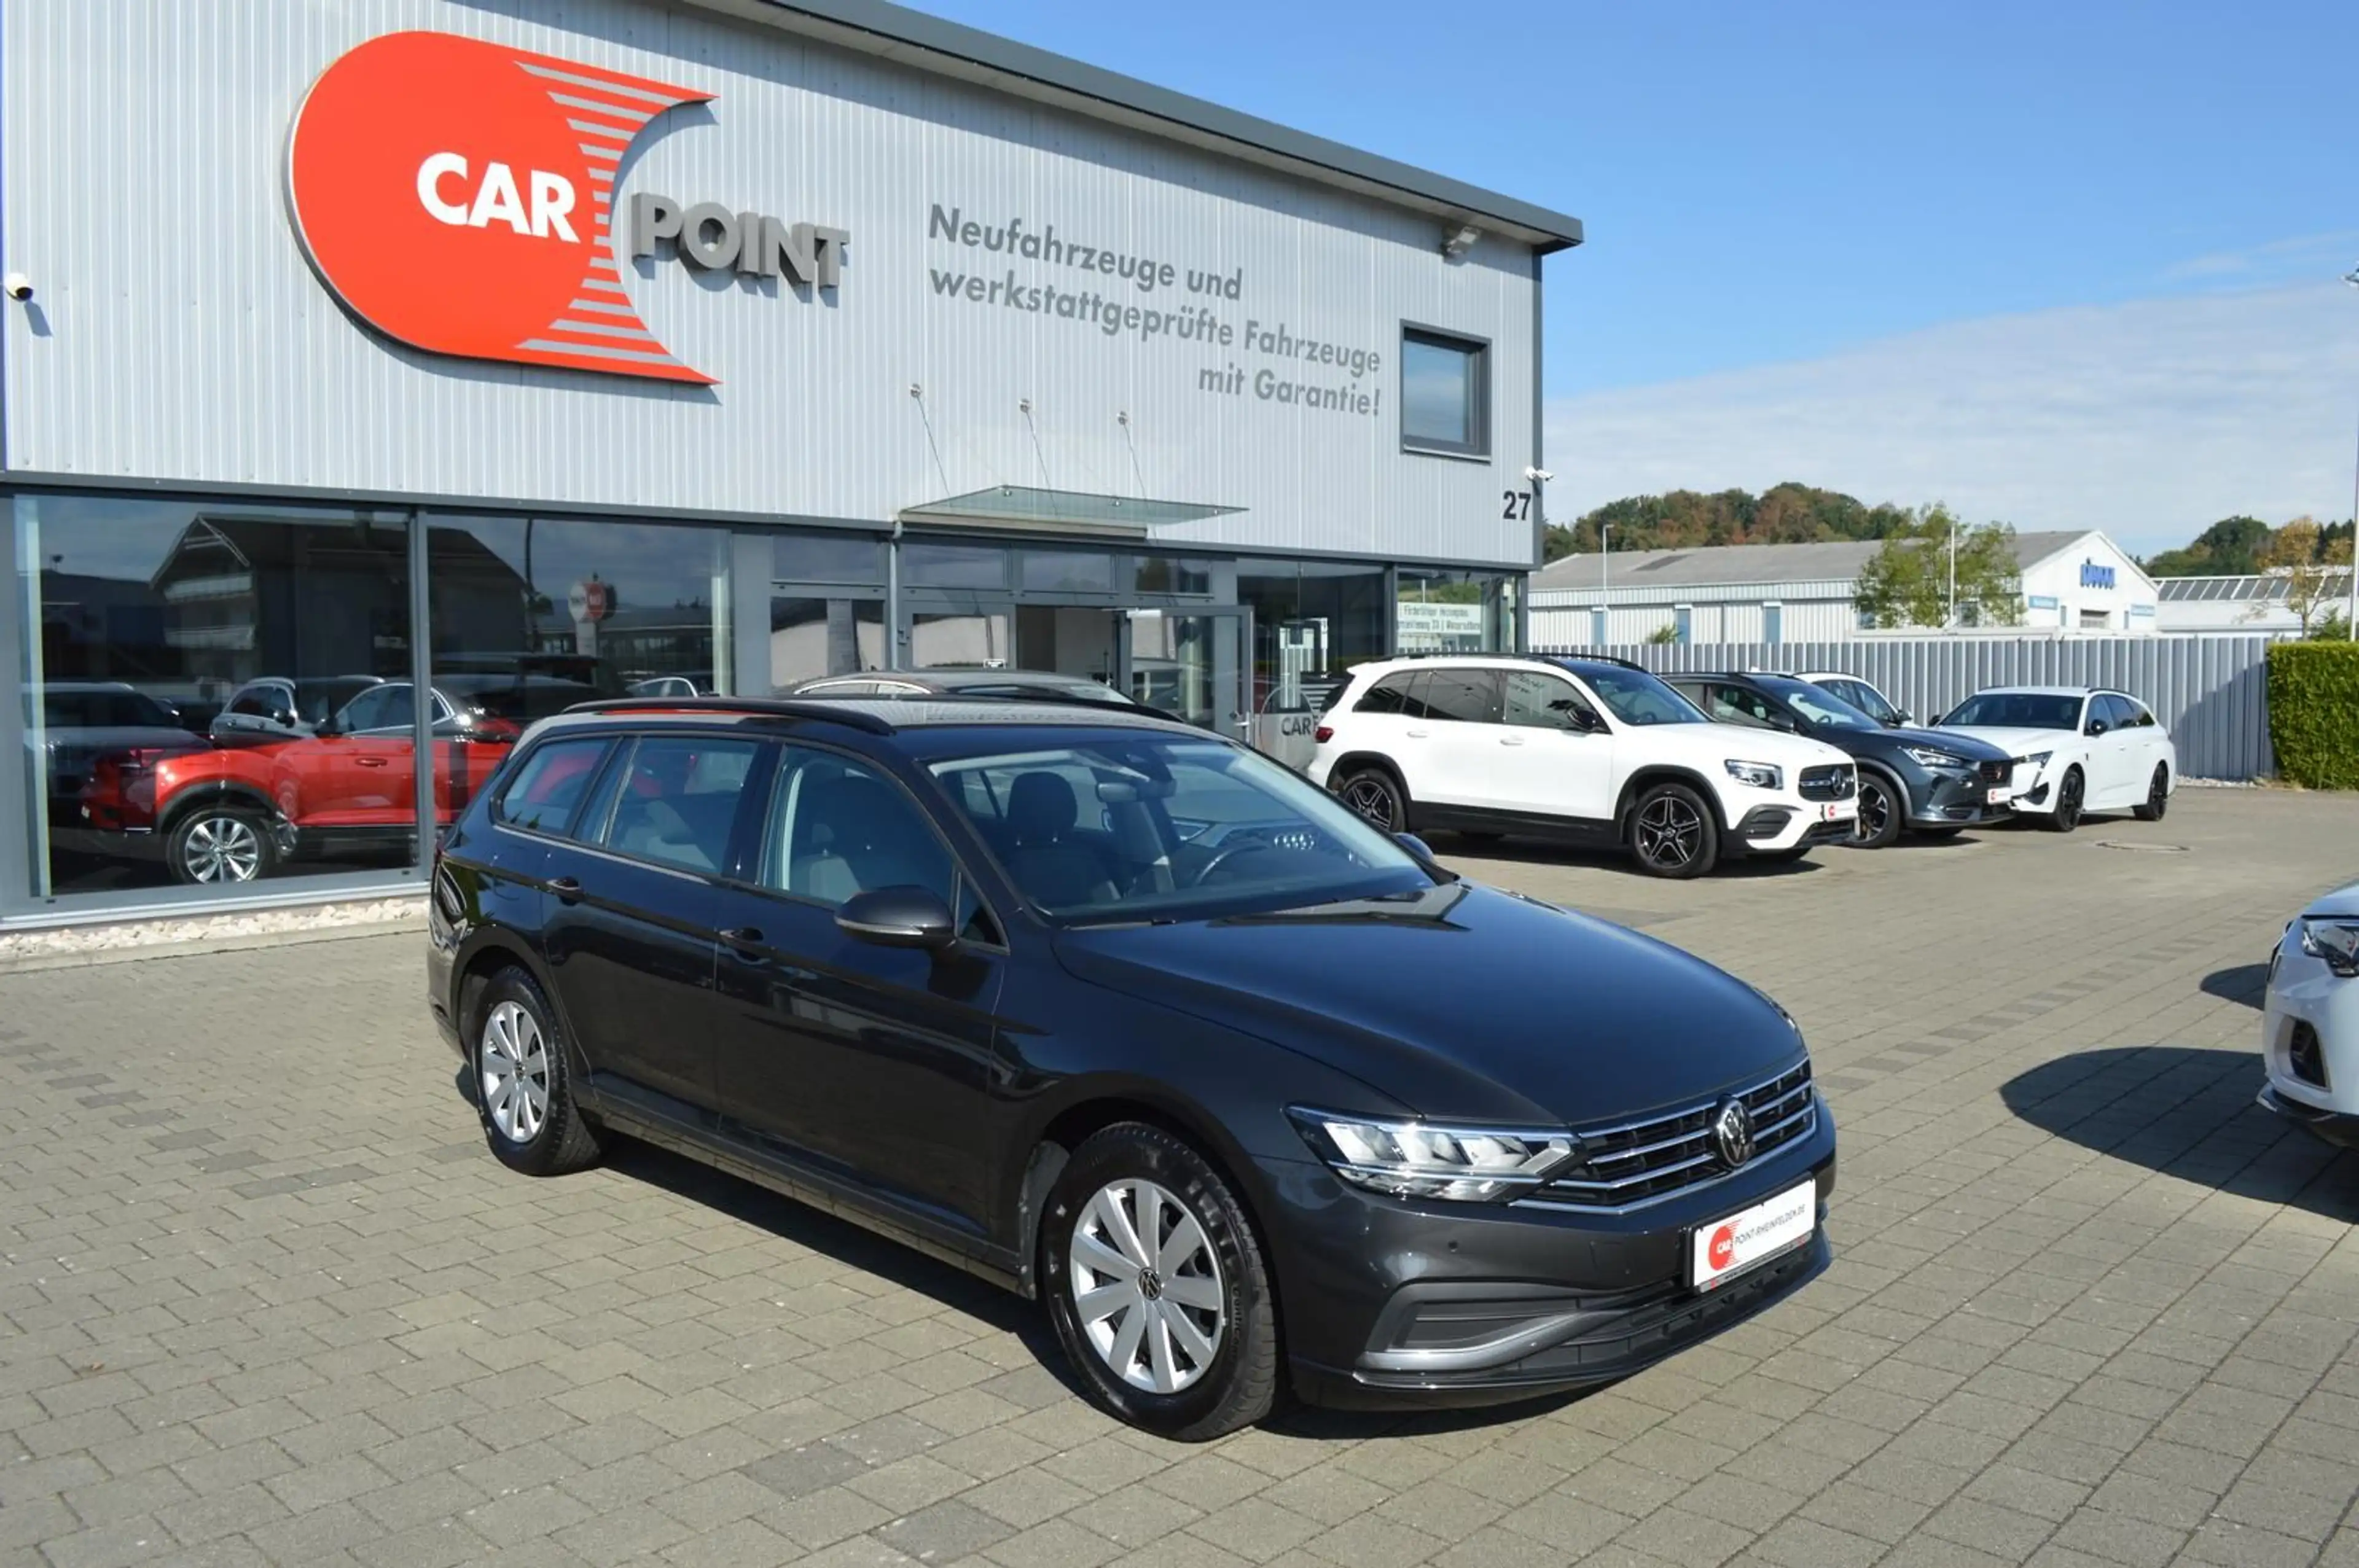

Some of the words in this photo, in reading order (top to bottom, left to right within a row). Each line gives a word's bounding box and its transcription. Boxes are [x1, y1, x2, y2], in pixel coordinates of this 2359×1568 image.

[417, 151, 581, 244] CAR
[632, 192, 850, 287] POINT
[929, 204, 1175, 292] Neufahrzeuge
[1186, 268, 1242, 301] und
[929, 268, 1234, 346] werkstattgeprüfte
[1244, 319, 1380, 378] Fahrzeuge
[1198, 363, 1245, 395] mit
[1254, 369, 1380, 416] Garantie!
[1503, 491, 1532, 520] 27
[1281, 717, 1312, 736] CAR
